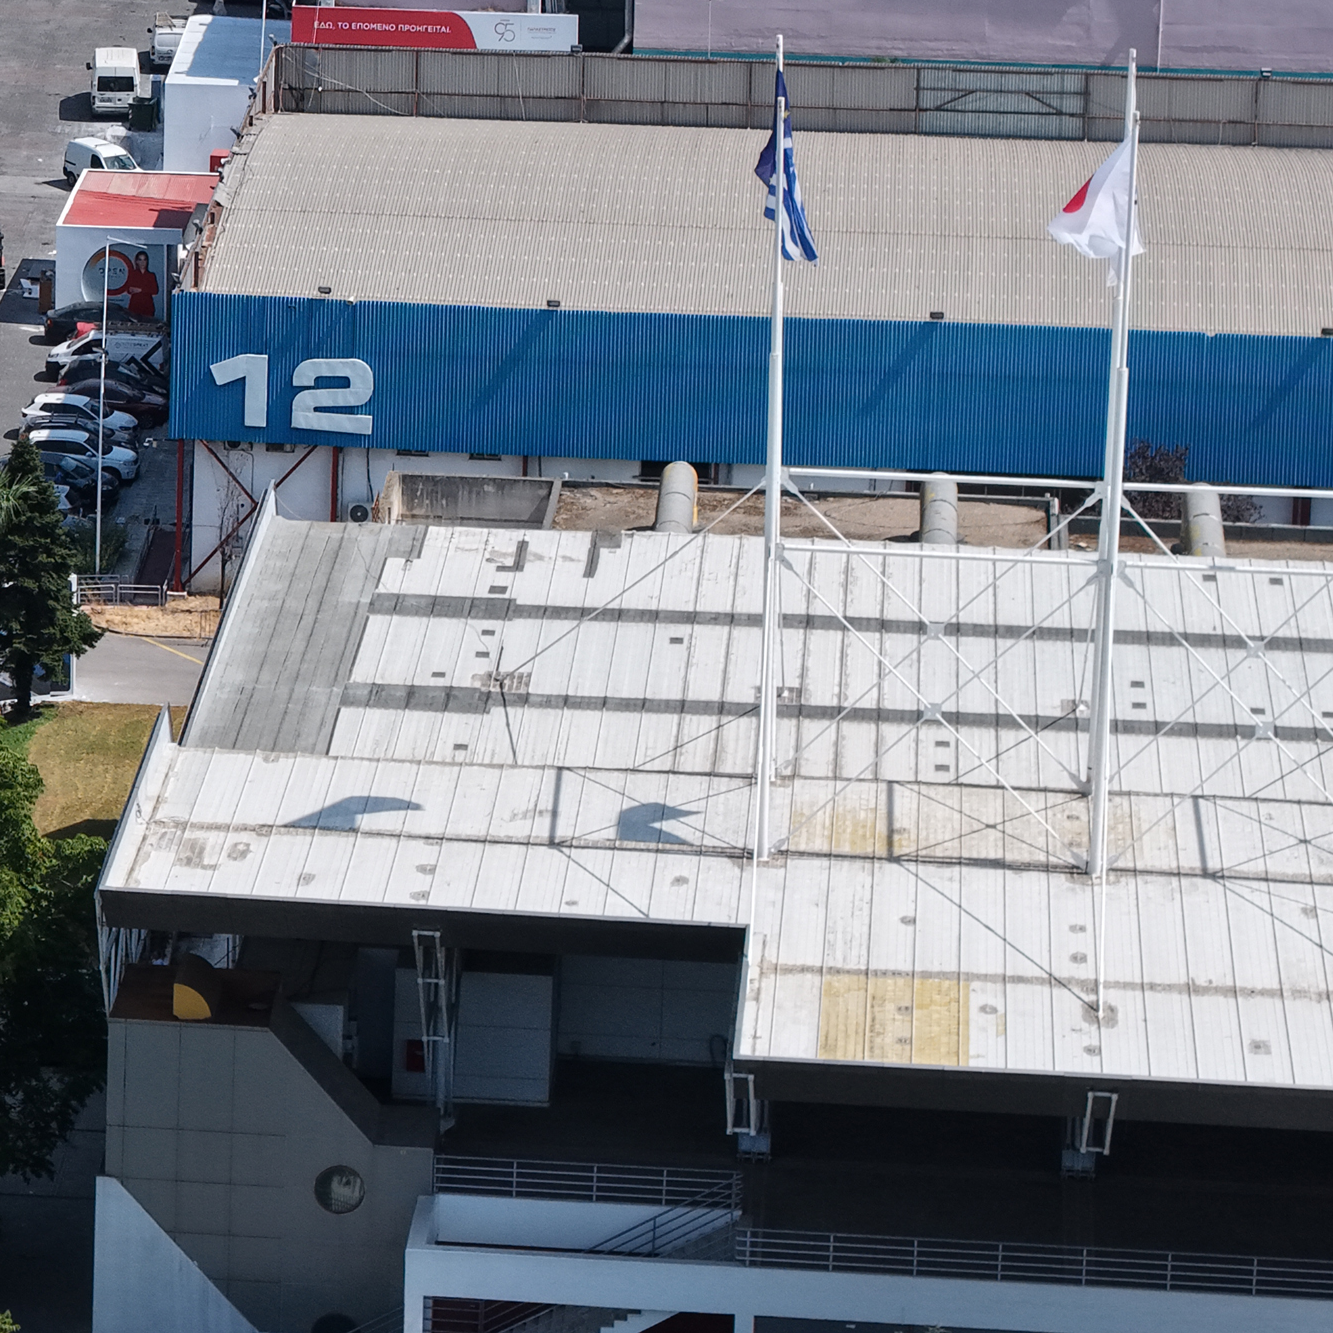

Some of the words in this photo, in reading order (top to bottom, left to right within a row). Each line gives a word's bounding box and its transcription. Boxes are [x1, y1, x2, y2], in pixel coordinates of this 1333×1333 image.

[352, 23, 396, 31] ΕΠΟΜΕΝΟ
[398, 24, 451, 33] ΠΡΟΗΓΕΙΤΑΙ.
[209, 353, 374, 436] 12
